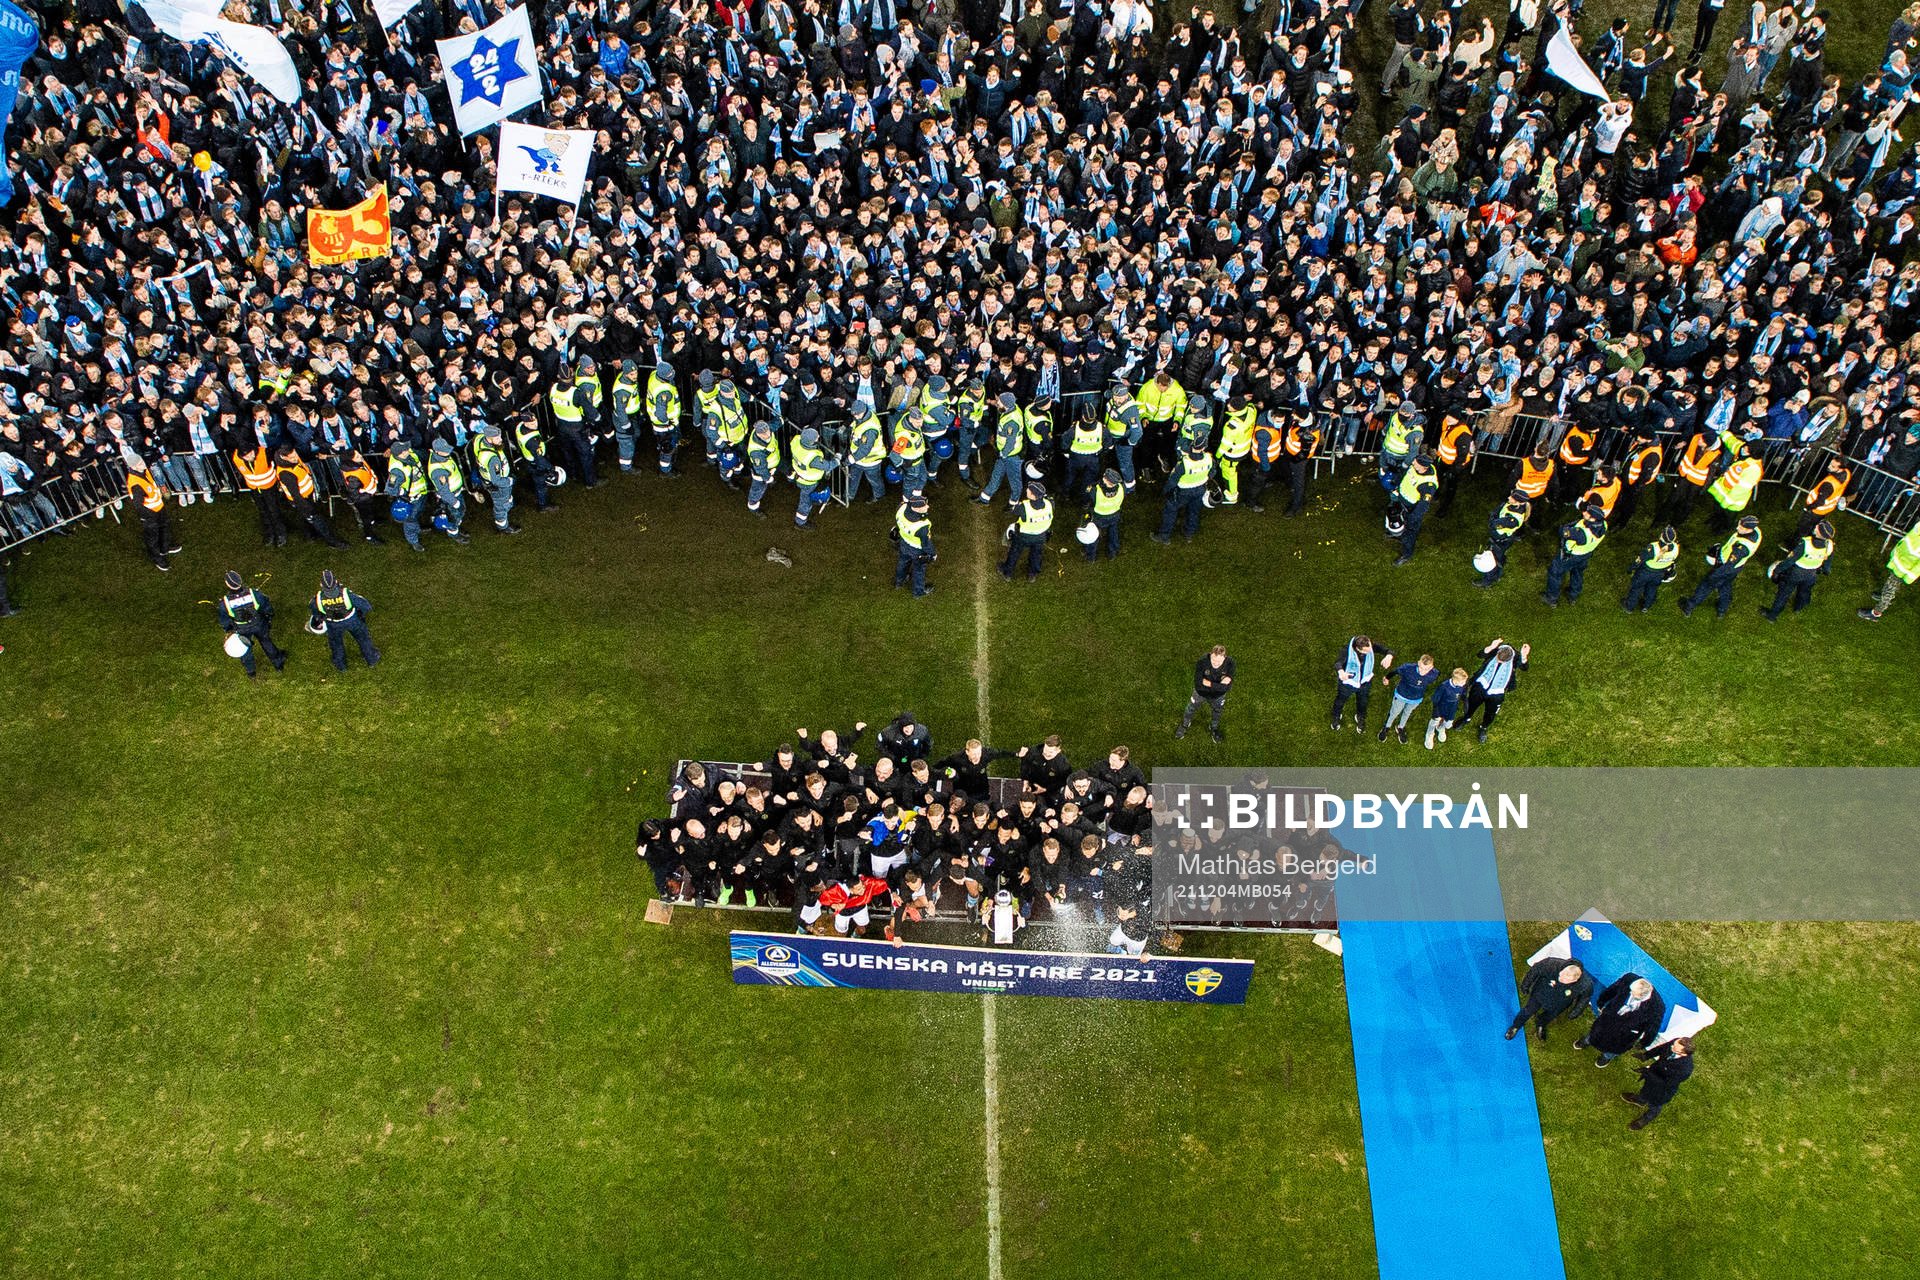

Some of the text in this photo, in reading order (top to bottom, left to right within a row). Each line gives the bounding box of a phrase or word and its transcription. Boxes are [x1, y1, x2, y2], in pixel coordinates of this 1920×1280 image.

[469, 48, 499, 73] 24
[481, 75, 500, 97] 2
[322, 597, 344, 606] POLIS
[956, 961, 1082, 980] MÄSTARE
[1090, 968, 1158, 983] 2021
[961, 979, 1016, 989] UNIBET
